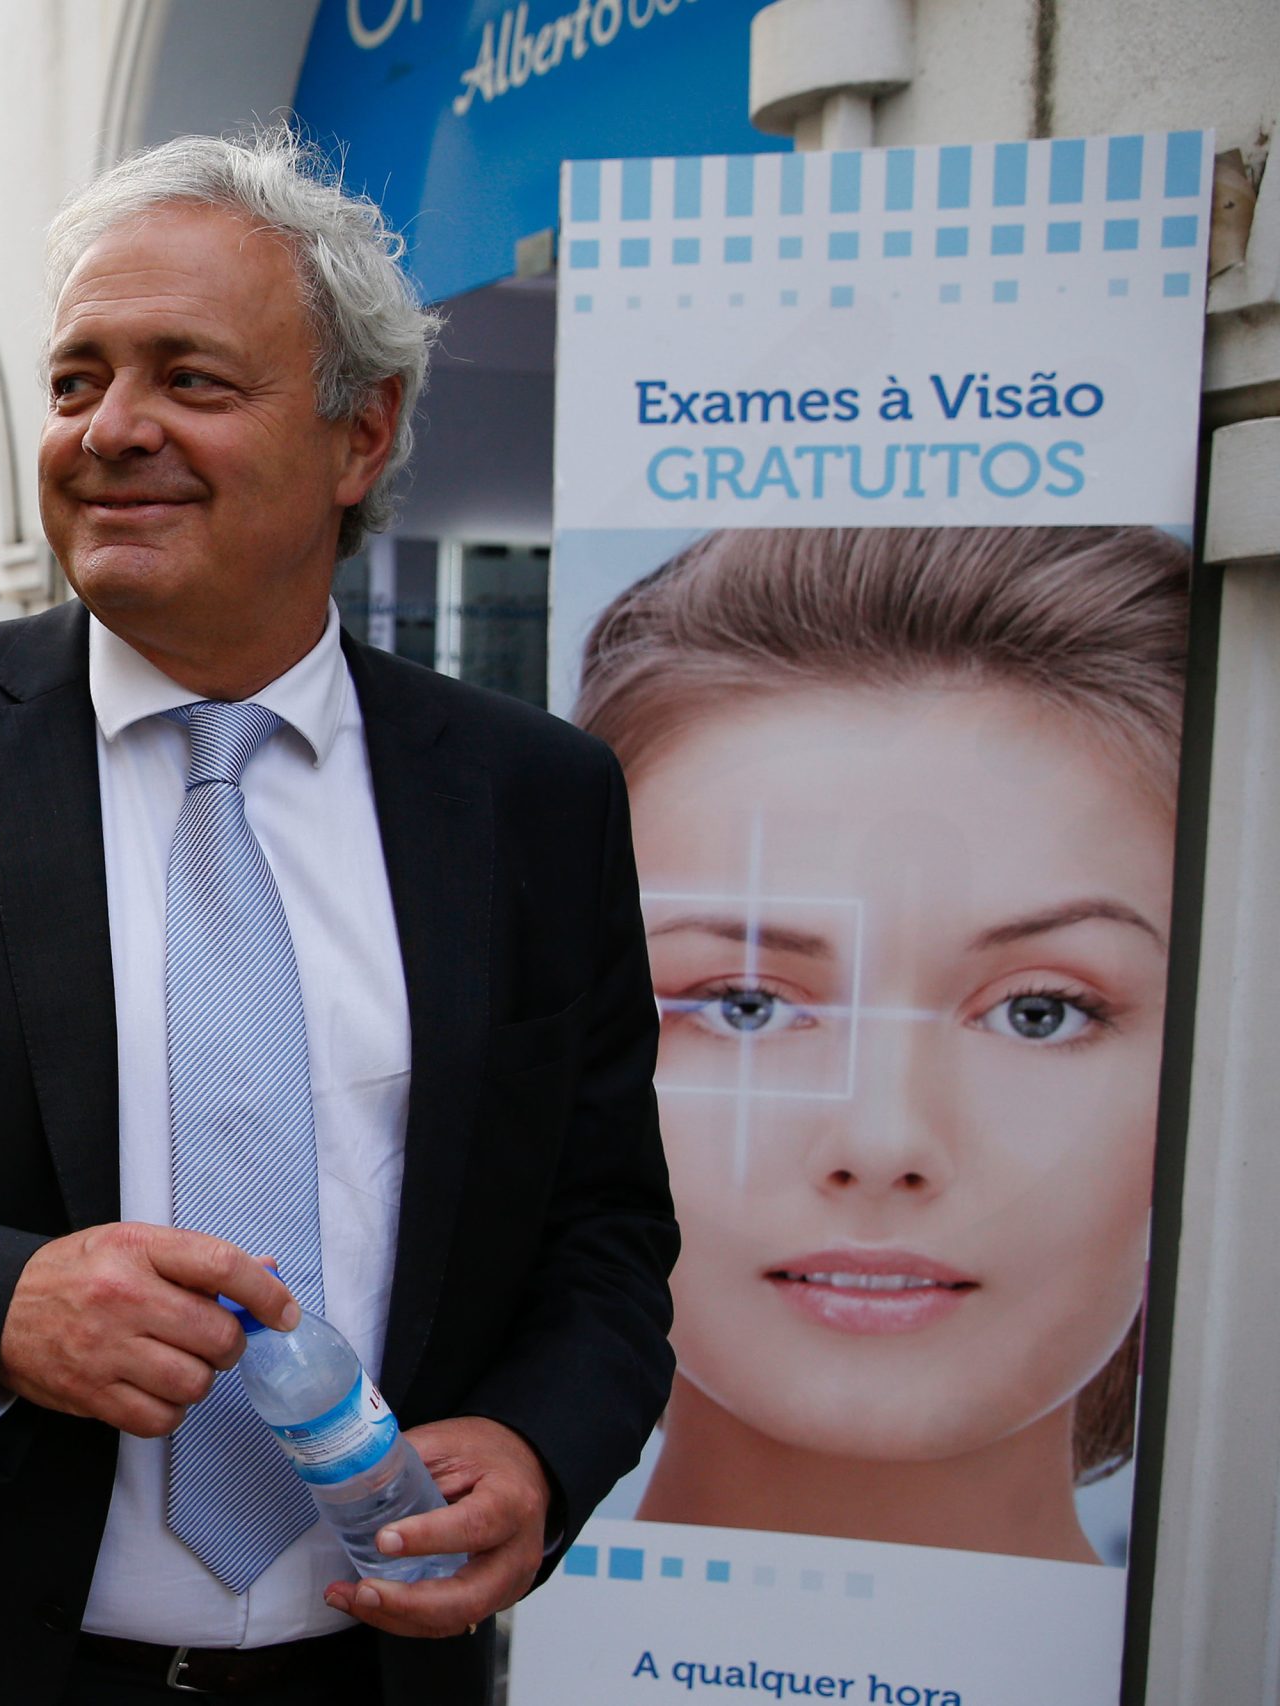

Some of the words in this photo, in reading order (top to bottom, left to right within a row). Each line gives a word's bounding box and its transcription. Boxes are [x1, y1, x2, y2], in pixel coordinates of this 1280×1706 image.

[452, 0, 622, 116] Alberto
[634, 379, 861, 426] Exames
[878, 374, 915, 422] à
[929, 371, 1105, 421] Visão
[645, 440, 1086, 502] GRATUITOS
[632, 1650, 660, 1681] A
[671, 1660, 856, 1700] qualquer
[867, 1673, 962, 1706] hora
